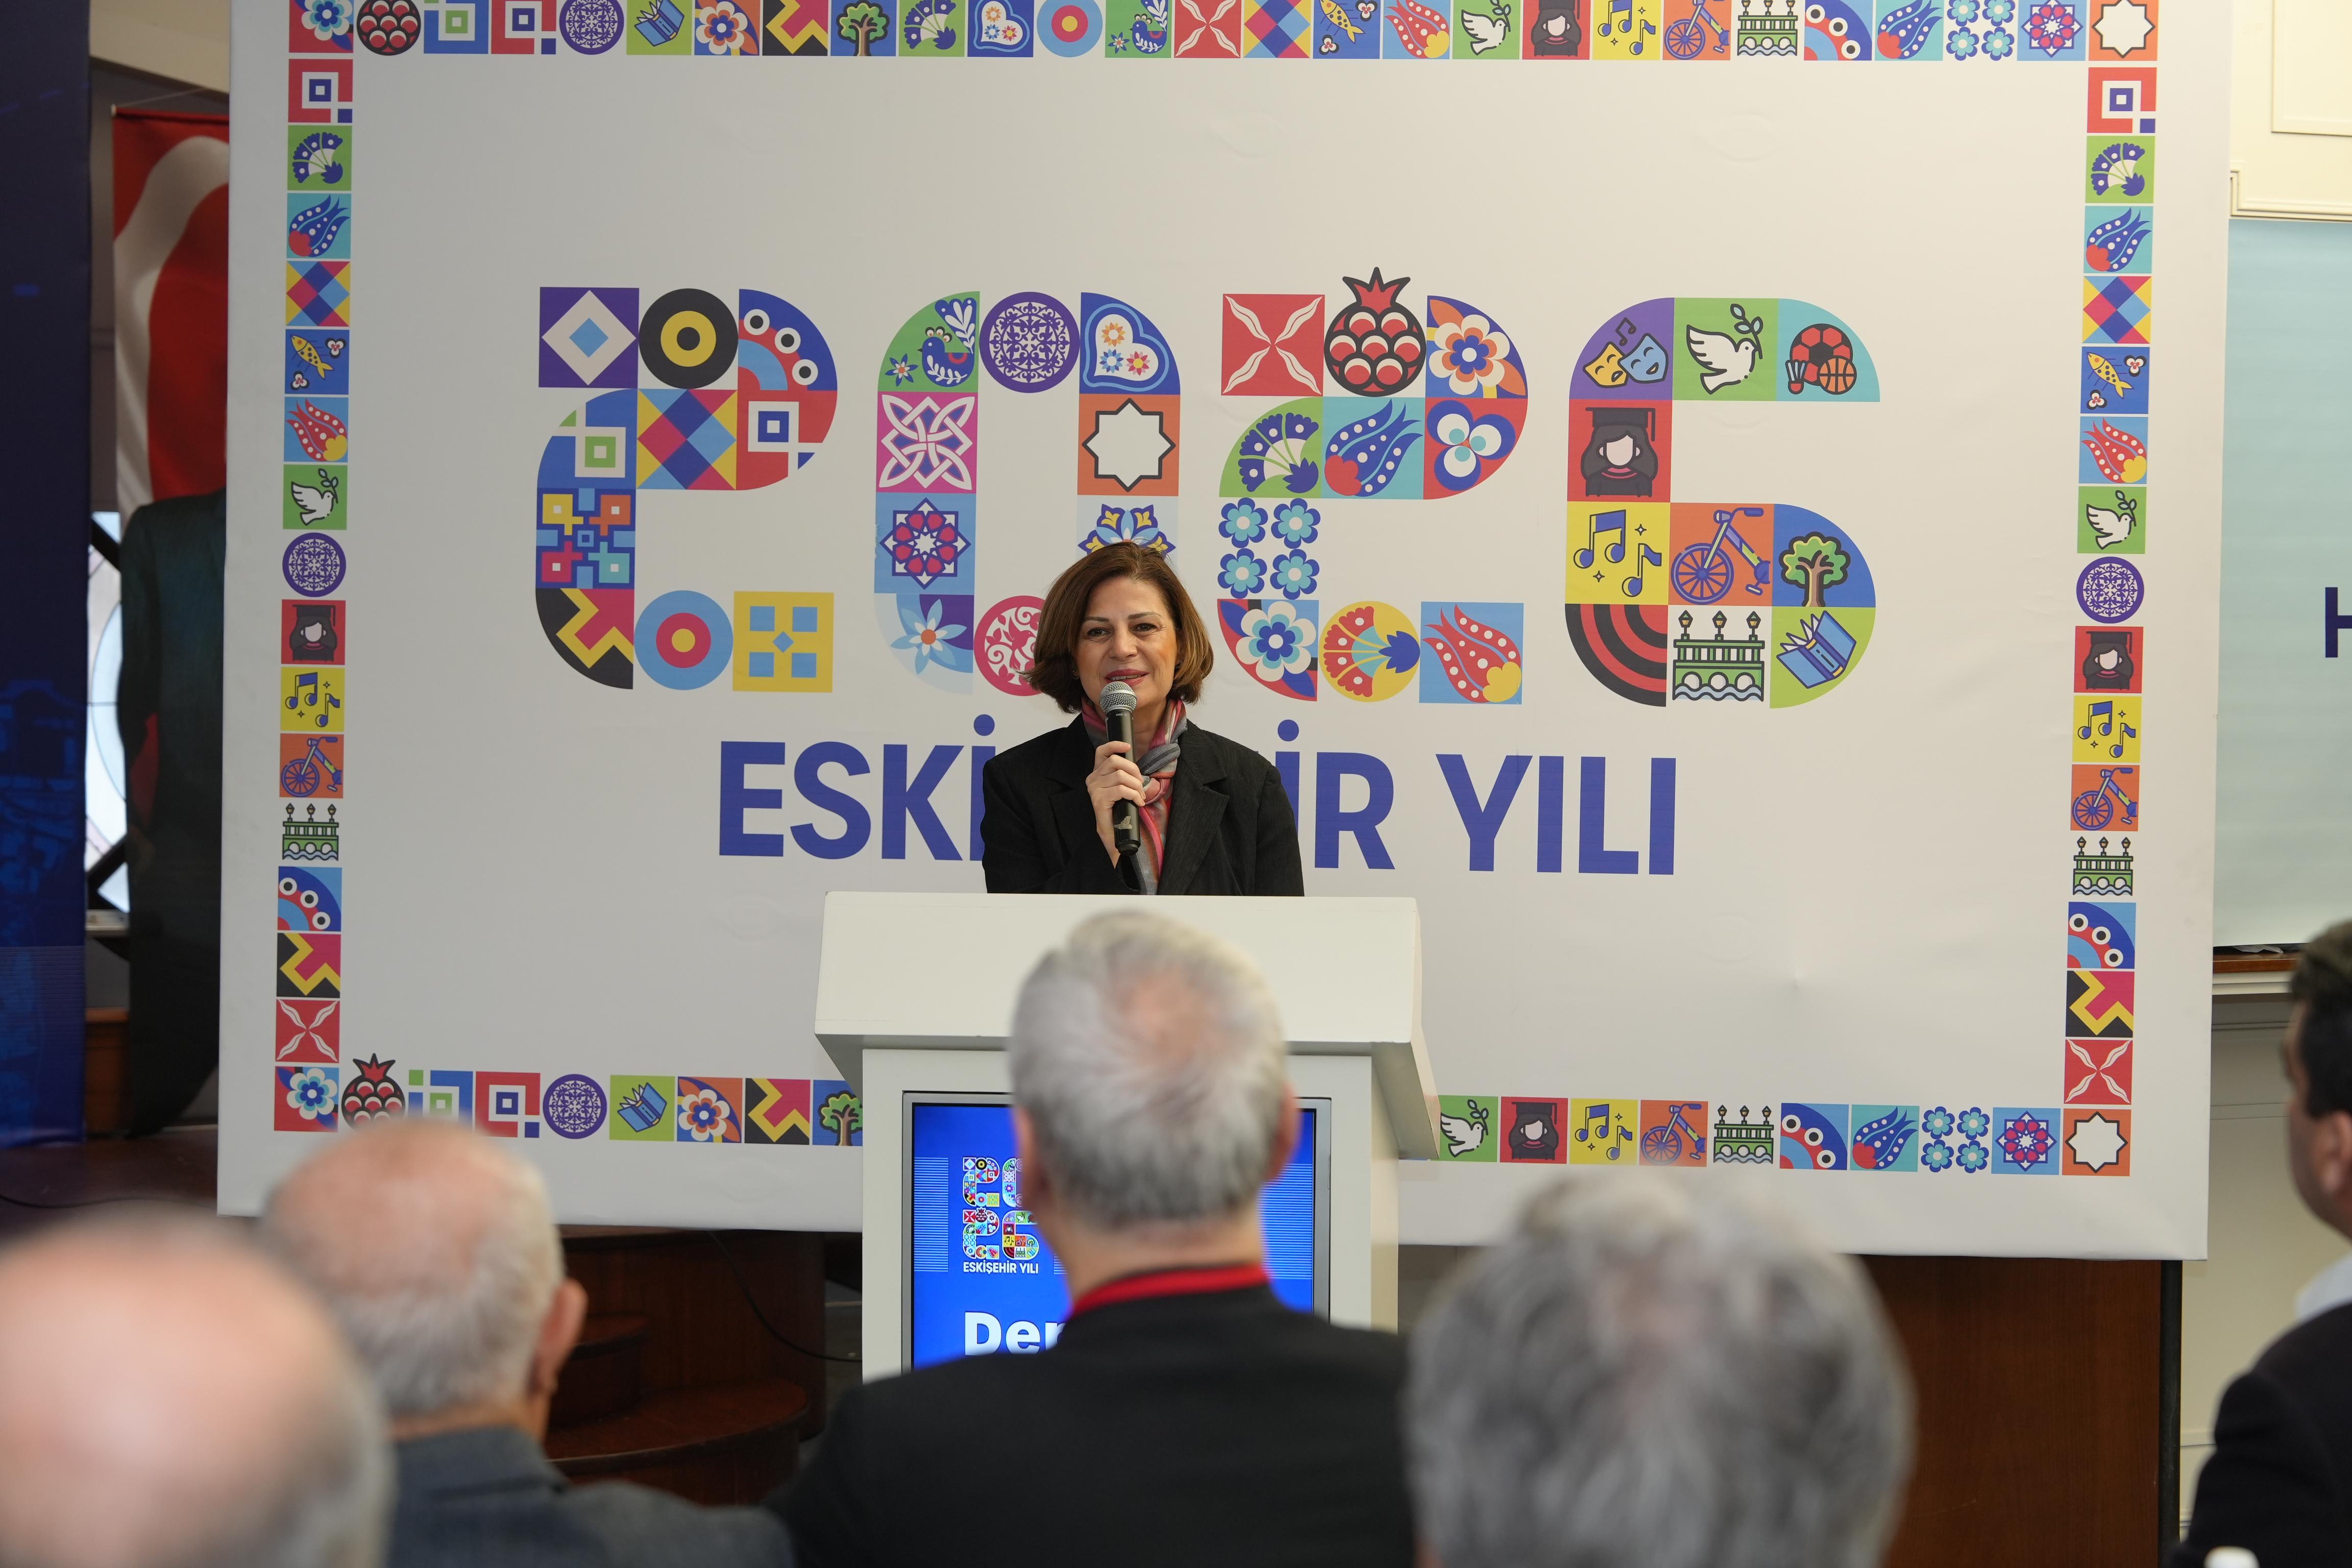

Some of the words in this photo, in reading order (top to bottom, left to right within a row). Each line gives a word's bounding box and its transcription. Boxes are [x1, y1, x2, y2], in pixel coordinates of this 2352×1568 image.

[719, 714, 1395, 870] ESKİİR
[1435, 753, 1676, 875] YILI
[963, 1259, 1017, 1275] ESKİŞEHİR
[1019, 1262, 1039, 1274] YILI
